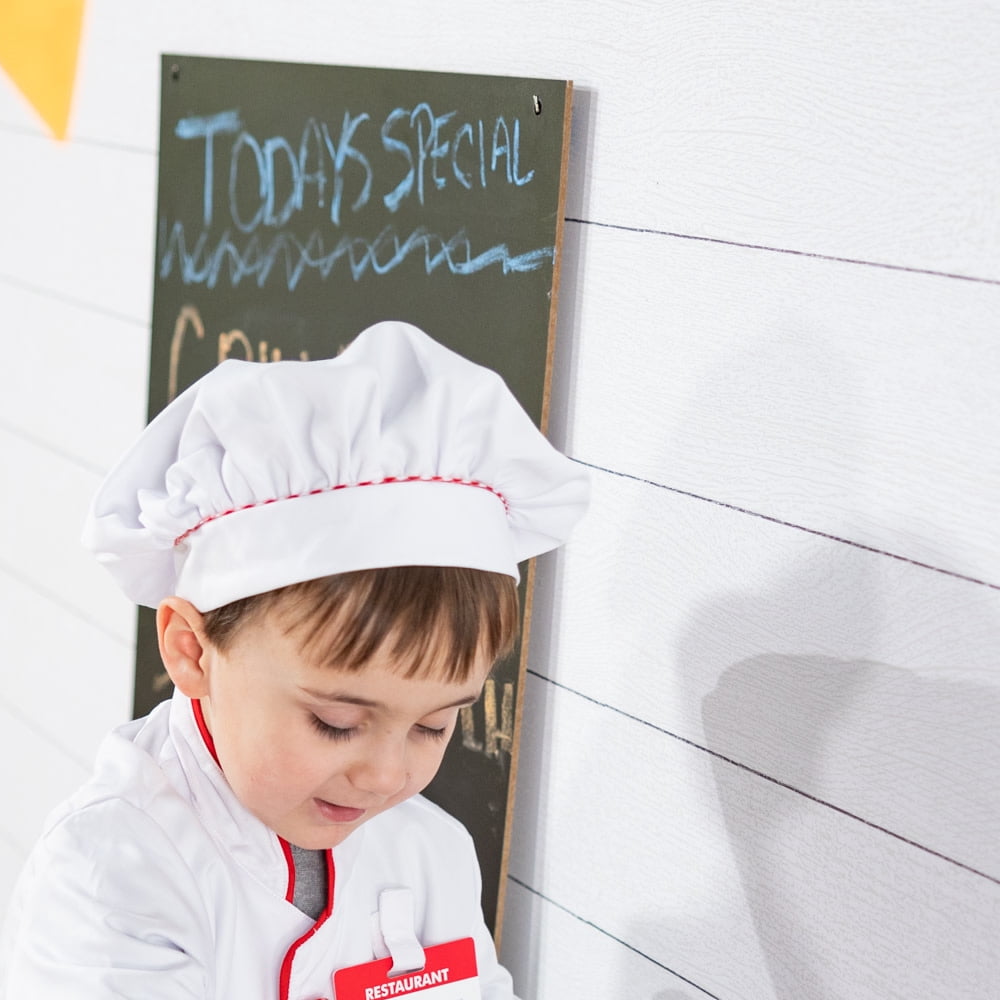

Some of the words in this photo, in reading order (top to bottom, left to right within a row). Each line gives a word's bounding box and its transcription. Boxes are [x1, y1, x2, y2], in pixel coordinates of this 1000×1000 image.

[174, 107, 373, 233] TODAYS
[381, 102, 536, 213] SPECIAL
[365, 968, 449, 1000] RESTAURANT
